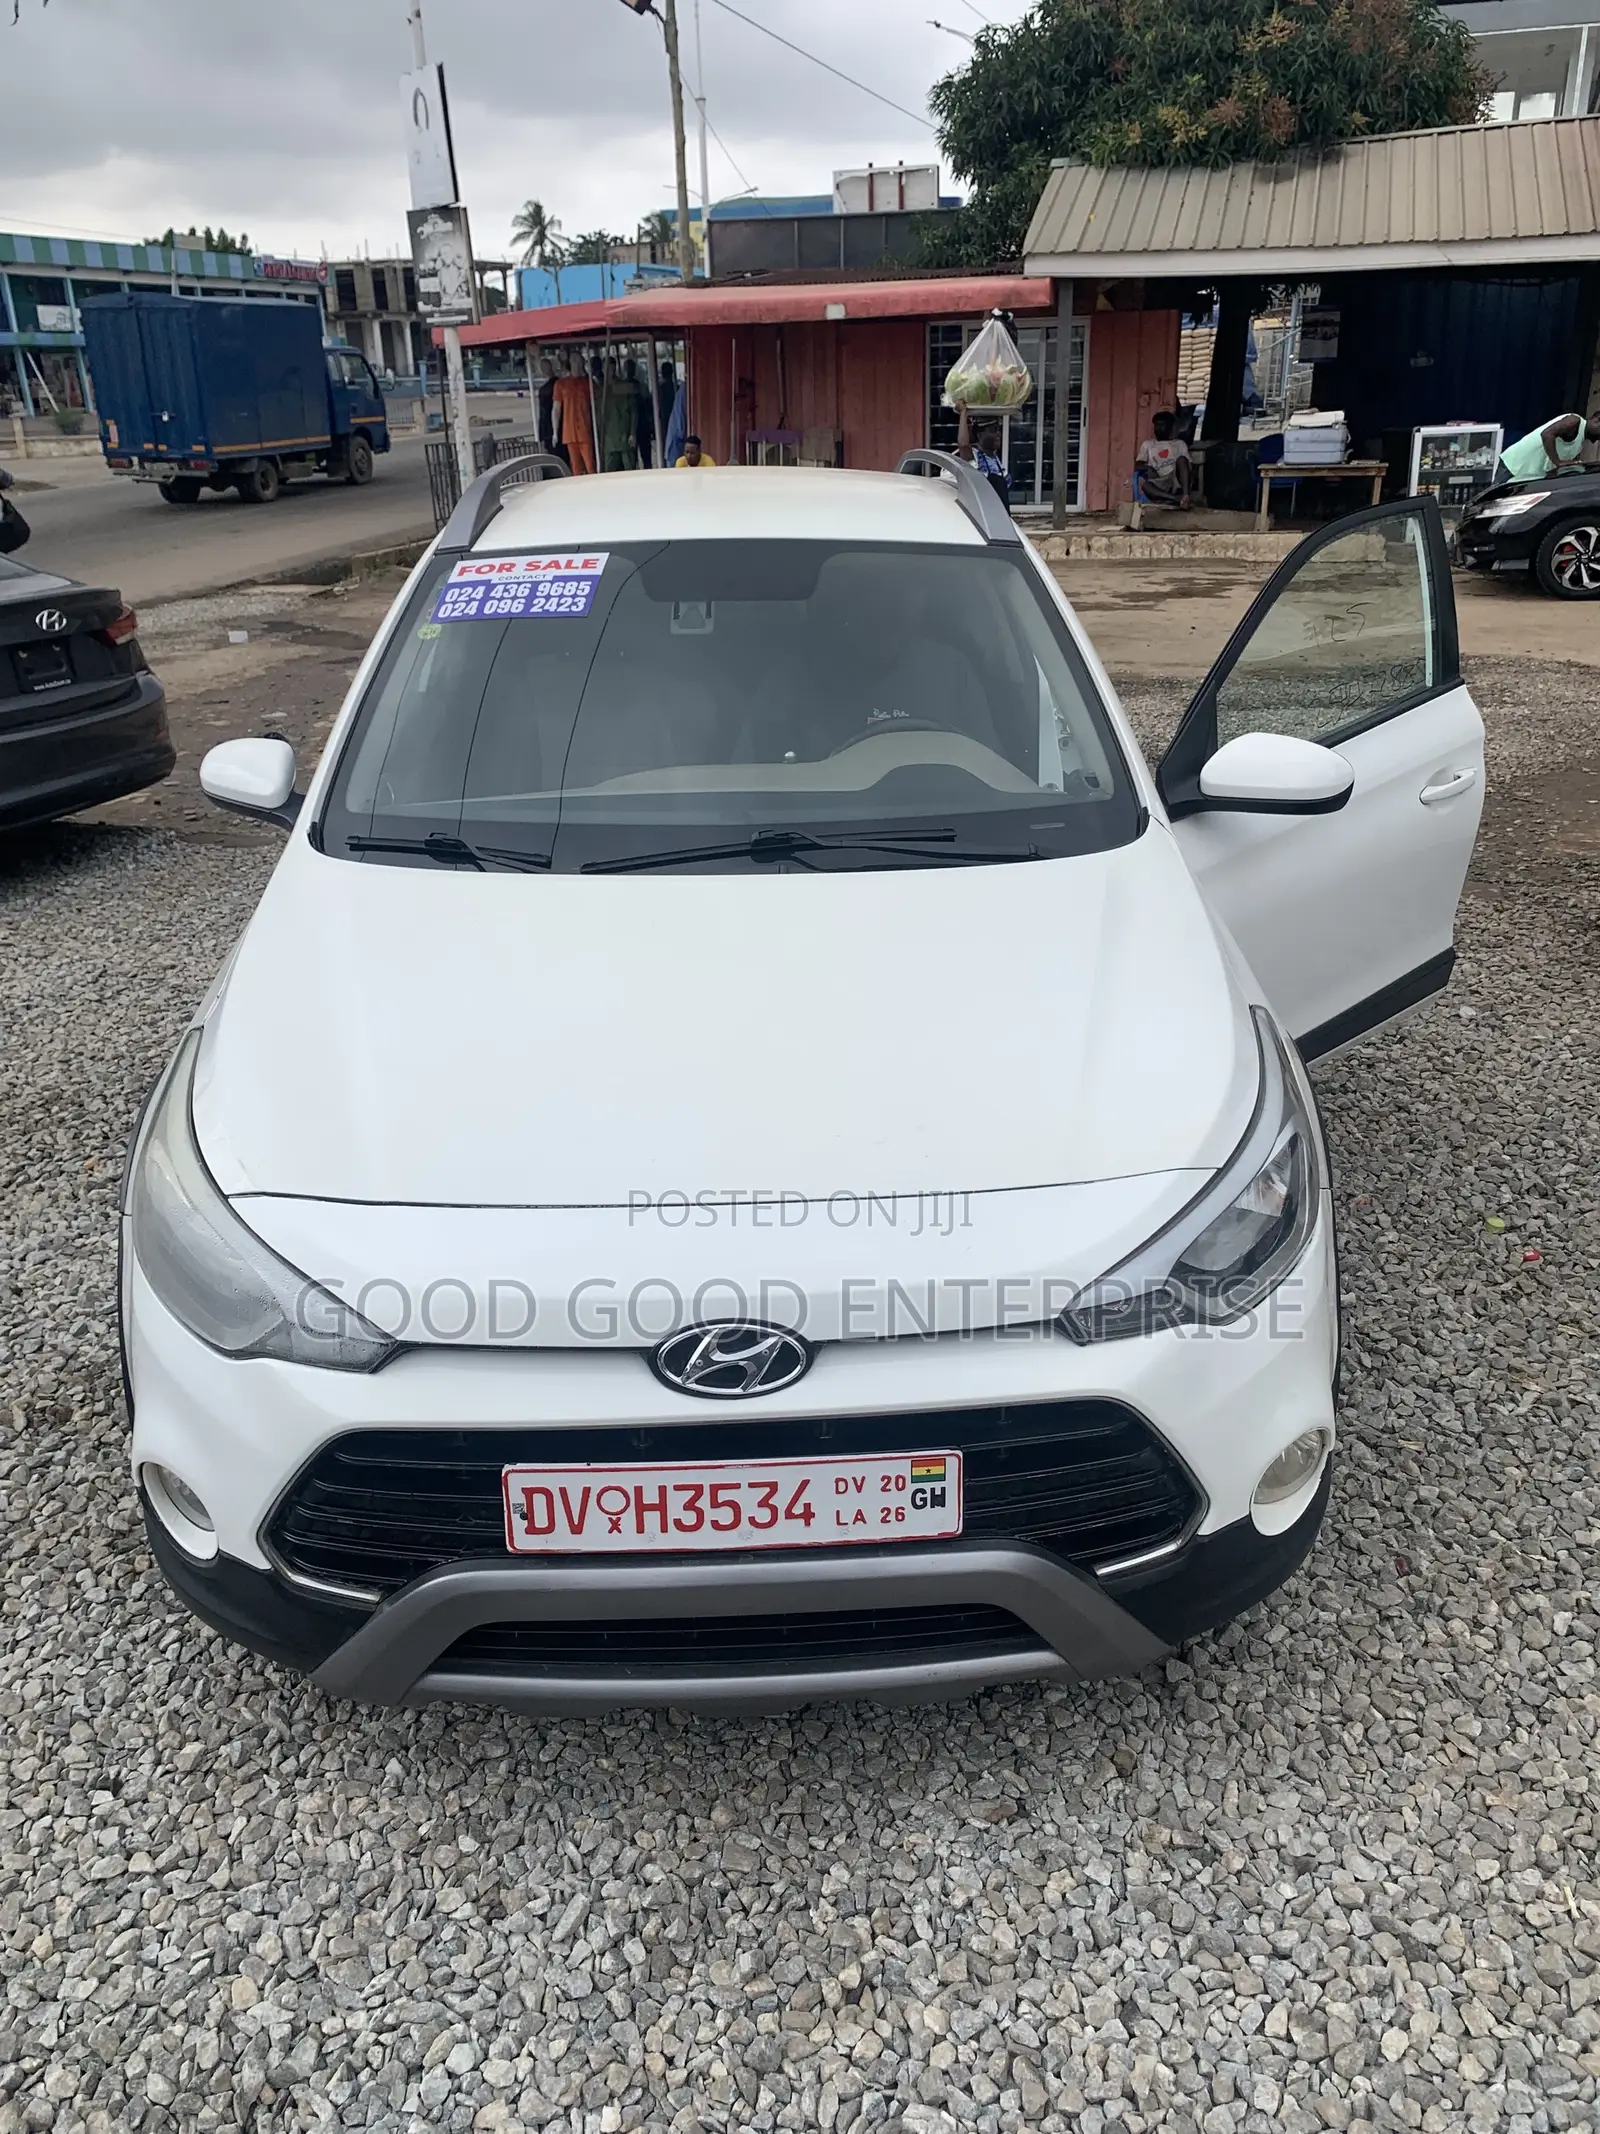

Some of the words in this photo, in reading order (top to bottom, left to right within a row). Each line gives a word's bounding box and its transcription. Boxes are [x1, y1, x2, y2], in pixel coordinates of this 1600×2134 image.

[457, 562, 516, 576] FOR
[523, 558, 599, 571] SALE
[444, 585, 485, 602] 024
[489, 583, 531, 598] 436
[536, 581, 592, 597] 9685
[437, 600, 481, 618] 024
[483, 598, 526, 614] 096
[529, 597, 586, 613] 2423
[834, 1475, 866, 1494] DV
[880, 1474, 906, 1492] 20
[910, 1486, 946, 1510] GH
[835, 1509, 867, 1526] LA
[880, 1506, 906, 1524] 26
